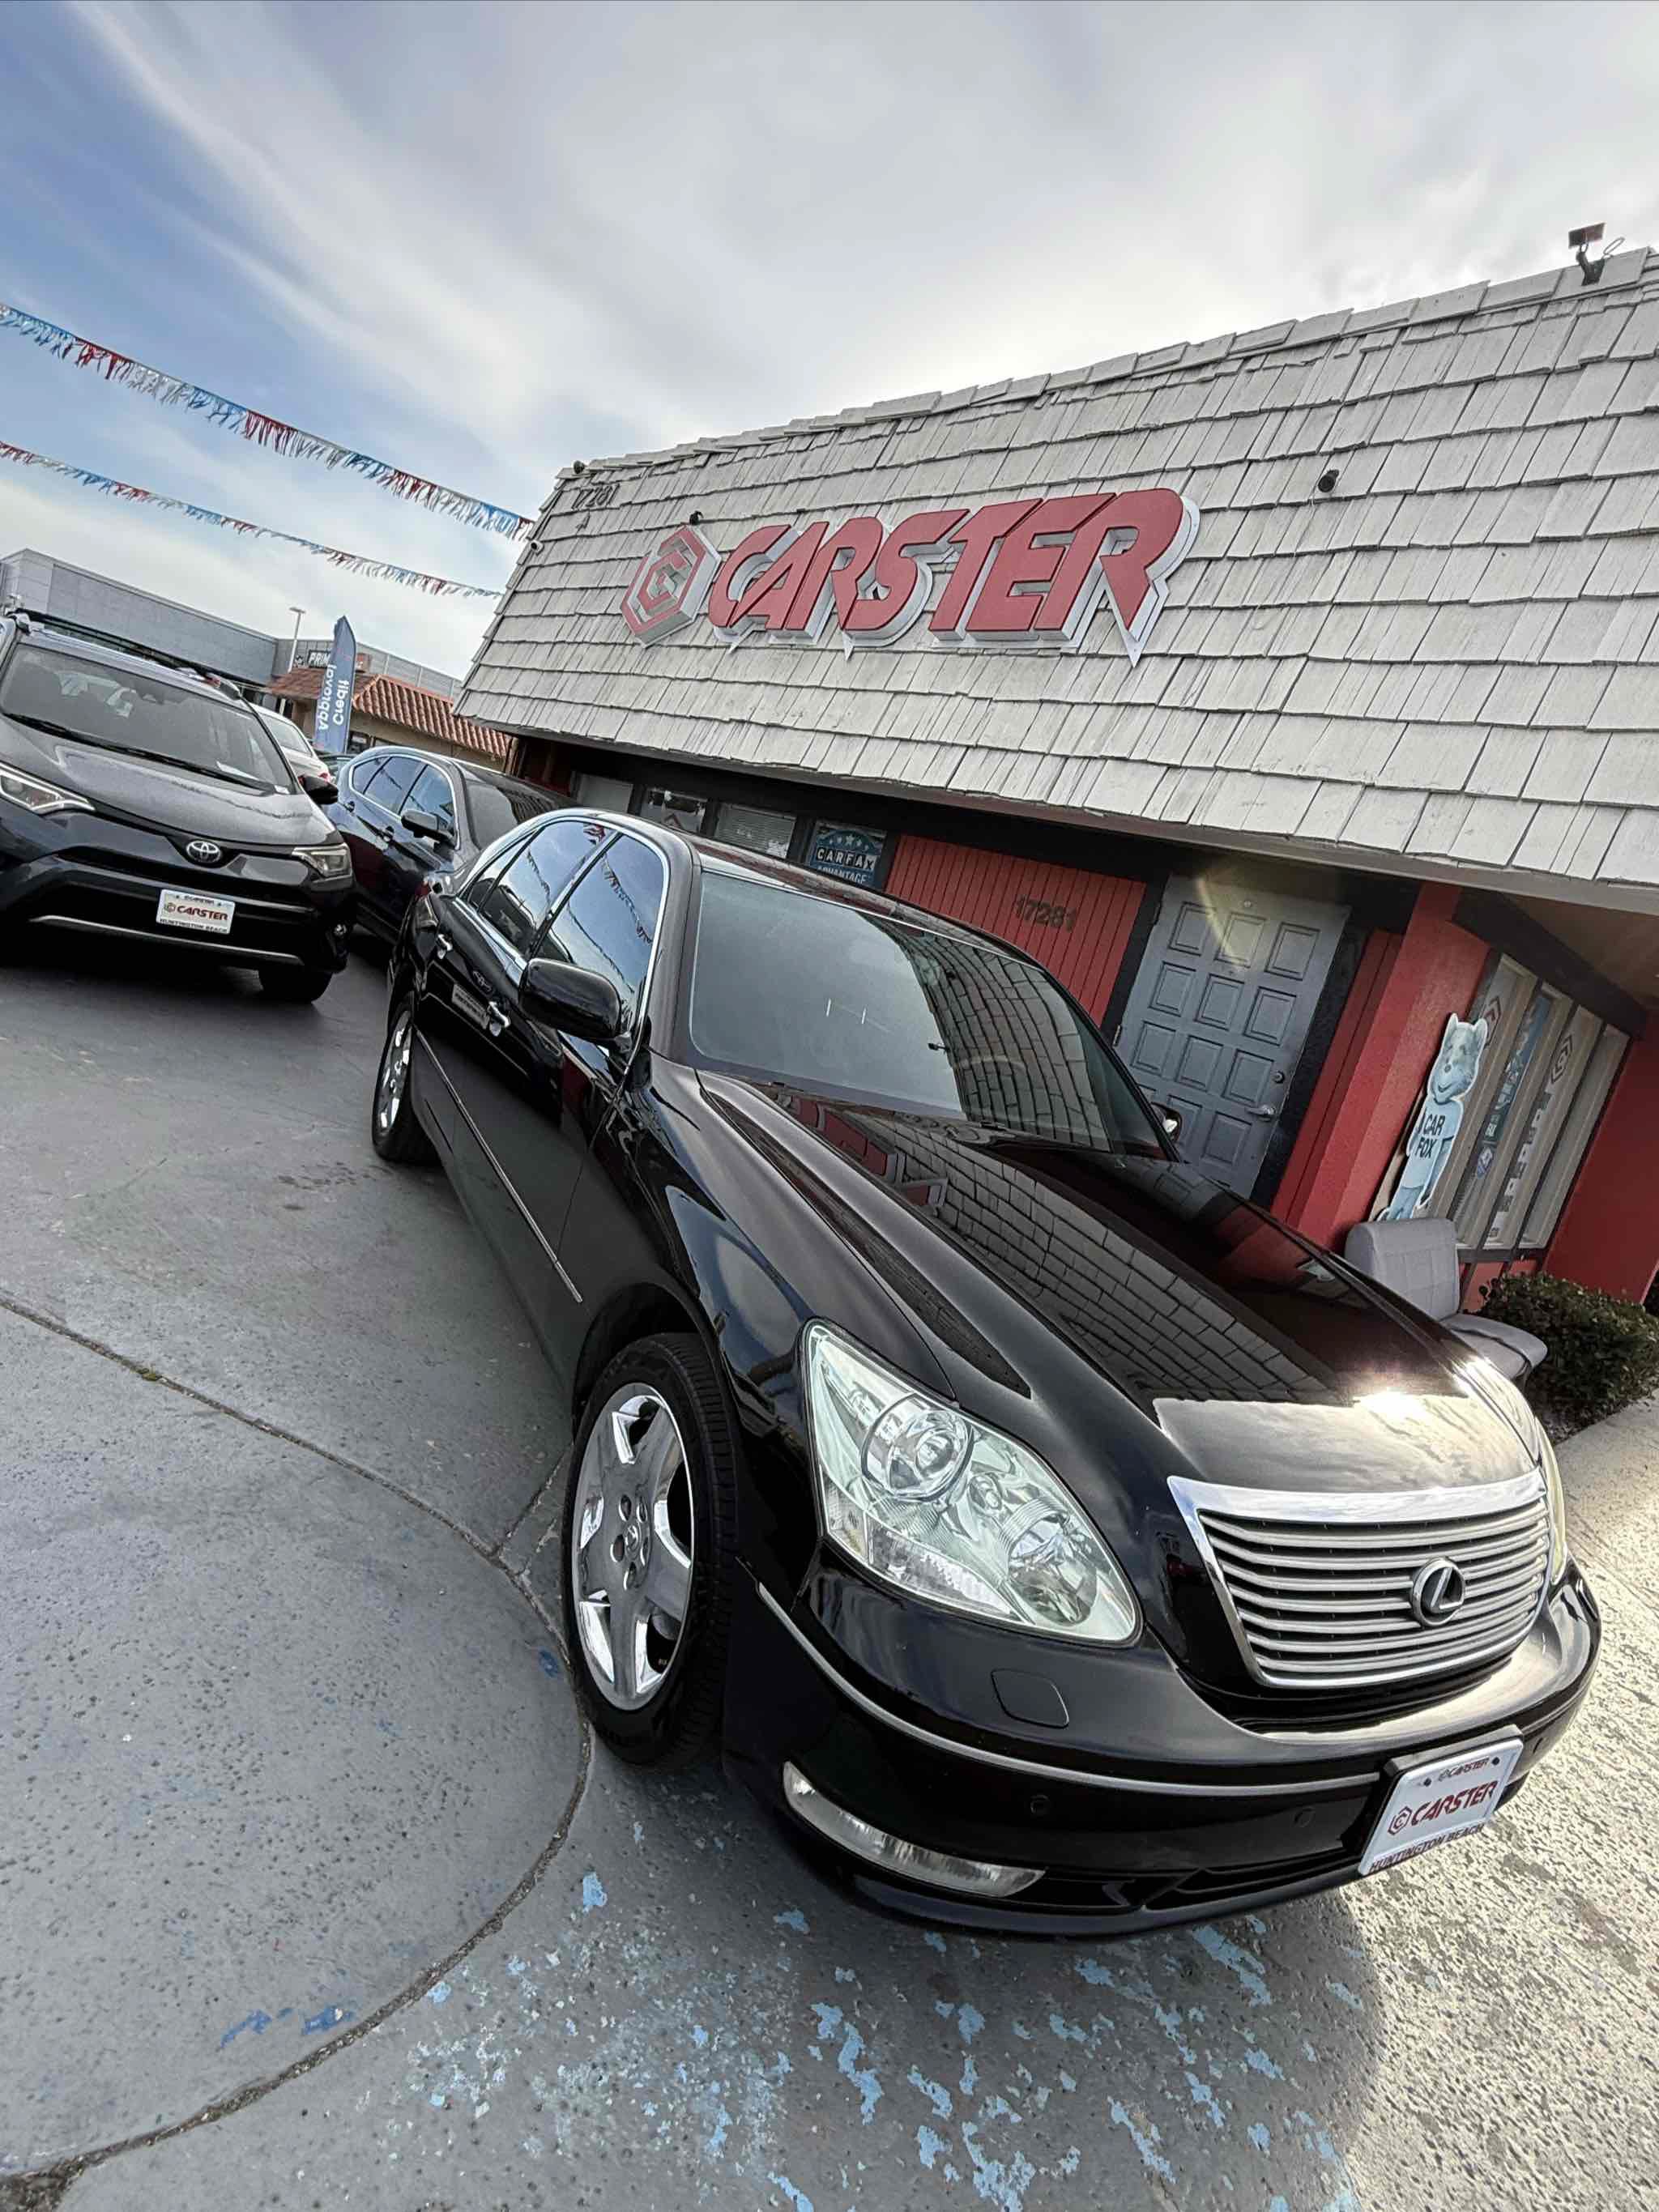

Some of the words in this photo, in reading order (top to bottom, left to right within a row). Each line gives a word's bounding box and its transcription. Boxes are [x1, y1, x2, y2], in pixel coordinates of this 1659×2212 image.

[706, 488, 1196, 654] CARSTER
[817, 848, 876, 872] CARFAX
[177, 906, 228, 921] CARSTER
[1016, 894, 1076, 933] 17281
[1423, 1114, 1446, 1136] CAR
[1415, 1136, 1438, 1158] FOX
[1448, 1757, 1490, 1778] CARSTER
[1411, 1779, 1499, 1827] CARSTER
[1370, 1835, 1446, 1873] HUNTINGTON
[1445, 1823, 1485, 1845] BEACH
